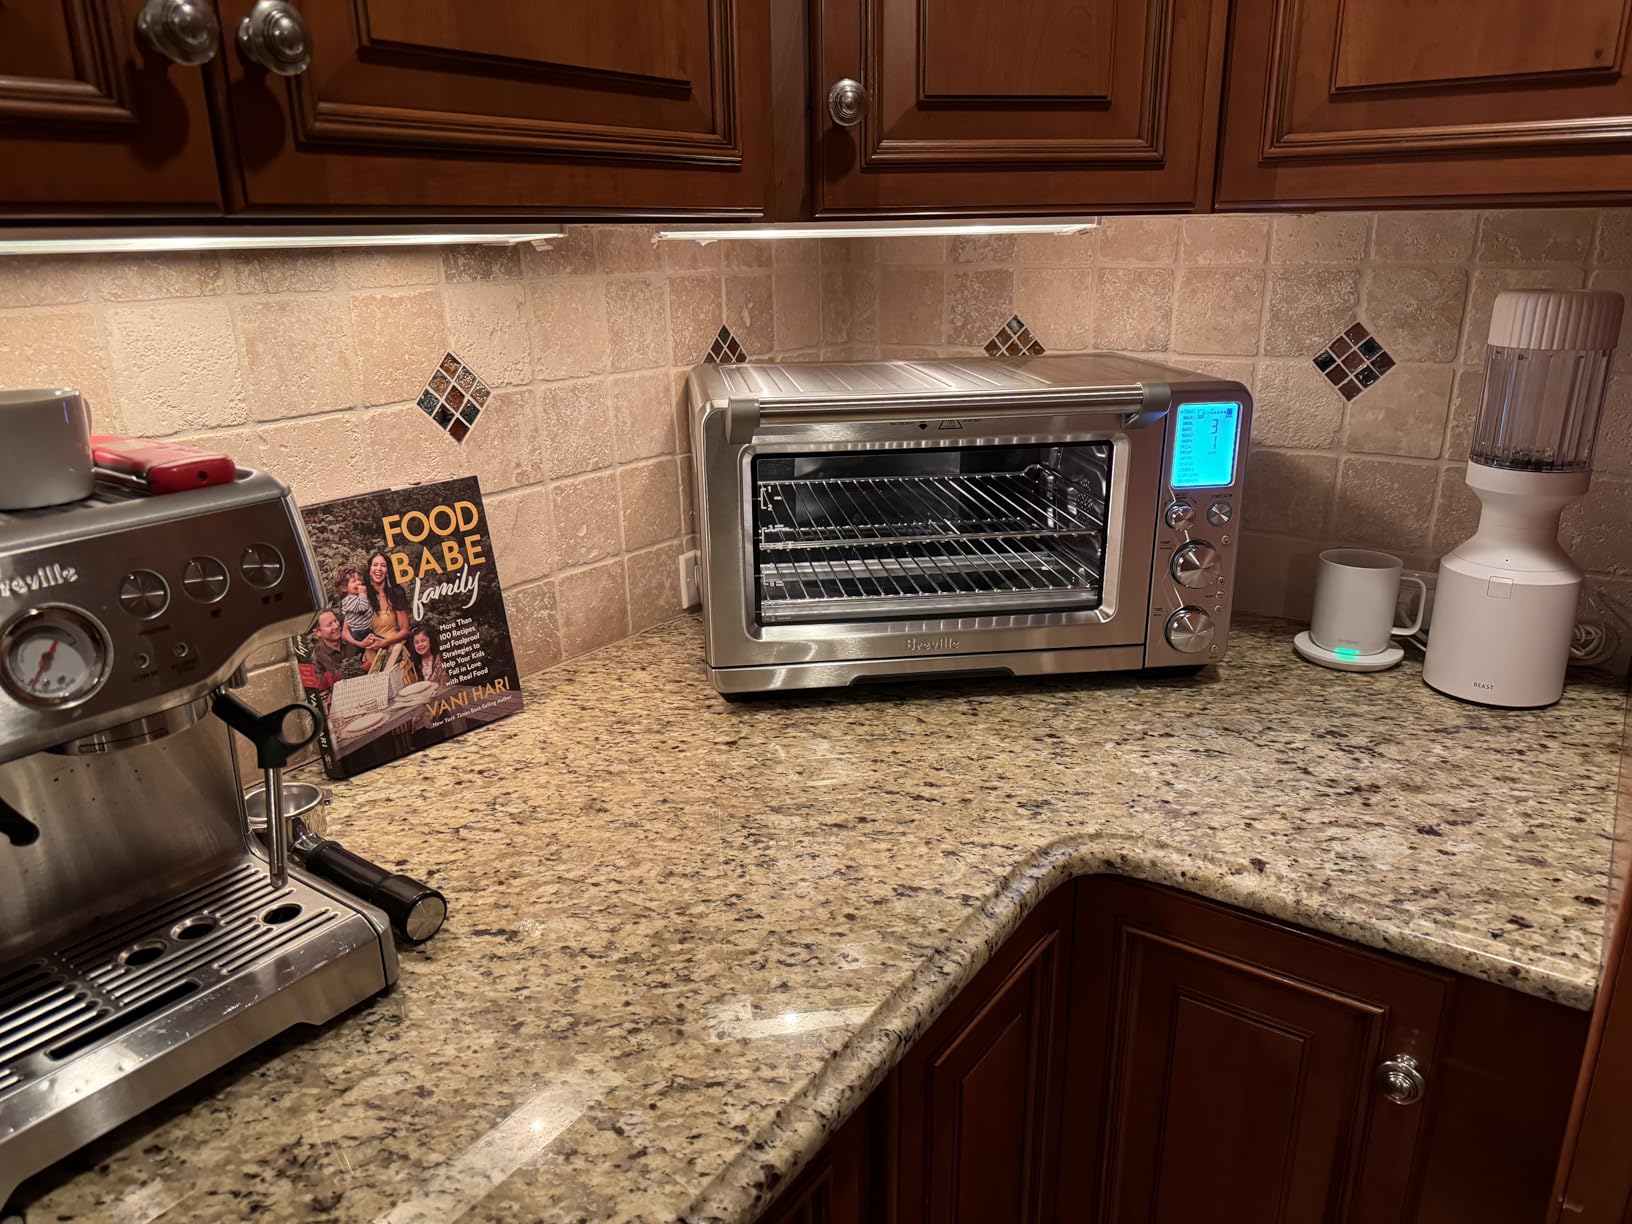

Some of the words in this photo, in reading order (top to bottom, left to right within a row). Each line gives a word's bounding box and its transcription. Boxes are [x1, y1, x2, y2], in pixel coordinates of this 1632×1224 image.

[382, 501, 479, 548] FOOD
[391, 534, 486, 584] BABE
[0, 563, 79, 597] reville
[413, 563, 480, 621] family
[440, 622, 456, 631] More
[456, 617, 473, 626] Than
[440, 631, 452, 641] 100
[452, 626, 476, 637] Recipes
[439, 642, 451, 651] and
[451, 632, 480, 647] Foolproof
[441, 659, 456, 669] Help
[456, 656, 471, 664] Your
[471, 650, 486, 660] Kids
[442, 645, 473, 659] Strategies
[445, 677, 459, 687] with
[459, 672, 473, 682] Real
[473, 666, 489, 677] Food
[449, 667, 460, 676] Fall
[467, 661, 482, 670] Love
[1473, 681, 1494, 690] BEAST
[426, 690, 469, 717] VANI
[472, 676, 510, 702] HARI
[432, 719, 444, 728] New
[456, 710, 471, 719] Times
[471, 700, 497, 714] Best-Selling
[497, 695, 512, 703] Author
